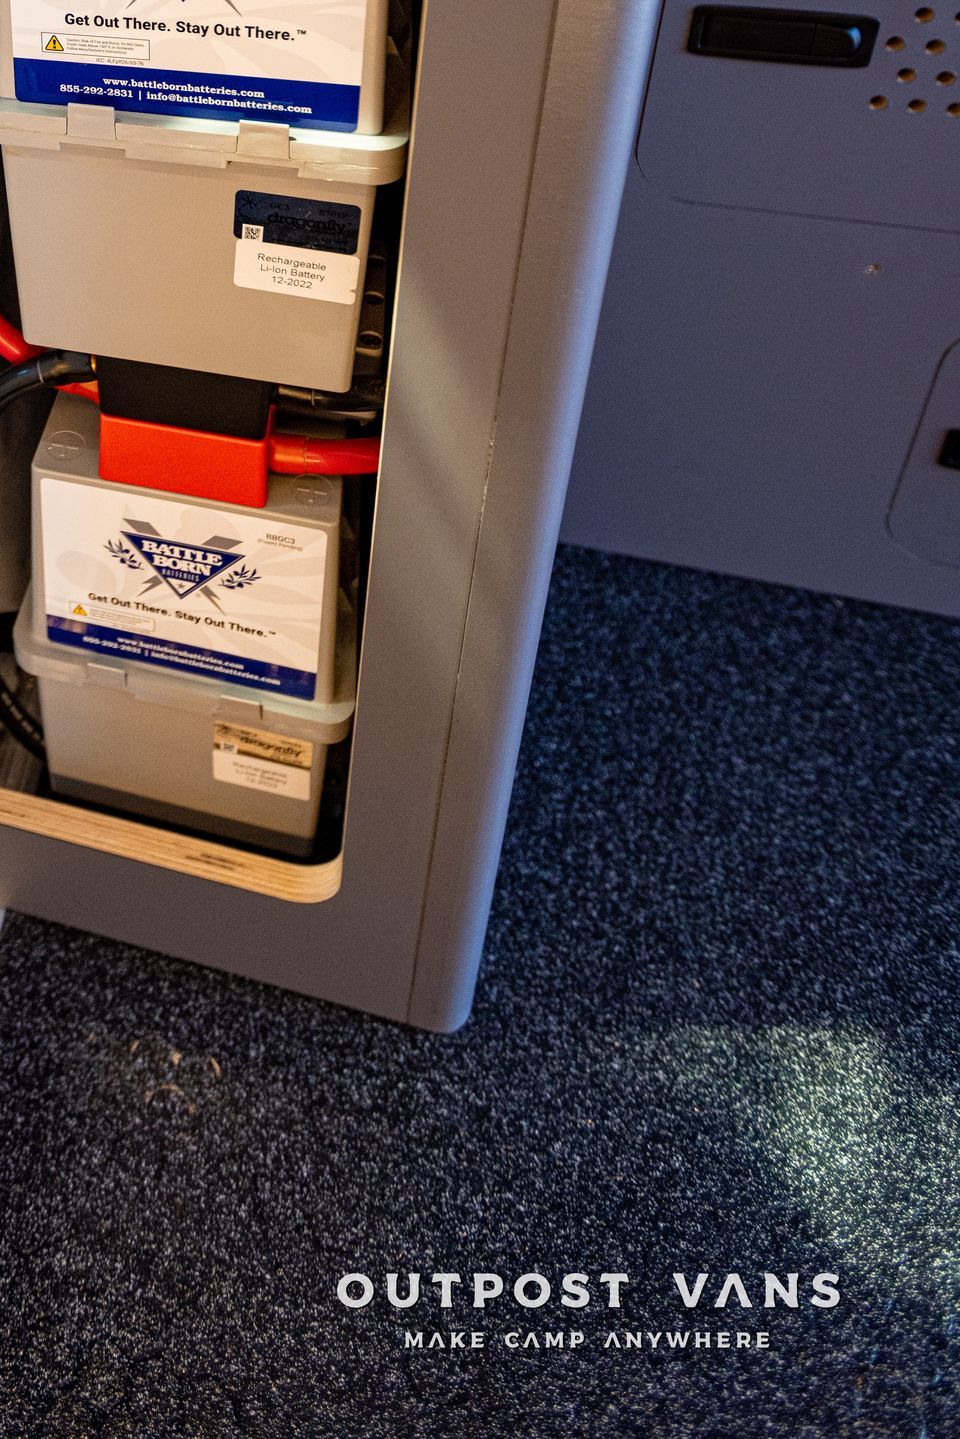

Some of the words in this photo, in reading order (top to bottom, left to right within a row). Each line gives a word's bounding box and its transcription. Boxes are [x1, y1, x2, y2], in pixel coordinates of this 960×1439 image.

[64, 13, 90, 26] Get
[93, 15, 120, 28] Out
[123, 17, 171, 32] There.
[176, 21, 209, 37] Stay
[214, 23, 240, 37] Out
[59, 83, 133, 98] 855-292-2831
[146, 91, 313, 114] info@battlebornbatteries.com
[102, 78, 266, 98] www.battlebornbatteries.com
[257, 252, 327, 271] Rechargeable
[272, 275, 313, 289] 12-2022
[290, 268, 325, 282] Battery
[141, 540, 224, 567] BATTLE
[152, 554, 212, 577] BORN
[161, 568, 200, 582] BATTERIES
[88, 592, 108, 604] Get
[110, 597, 131, 608] Out
[134, 601, 171, 617] There.
[174, 610, 201, 624] Stay
[204, 616, 225, 629] Out
